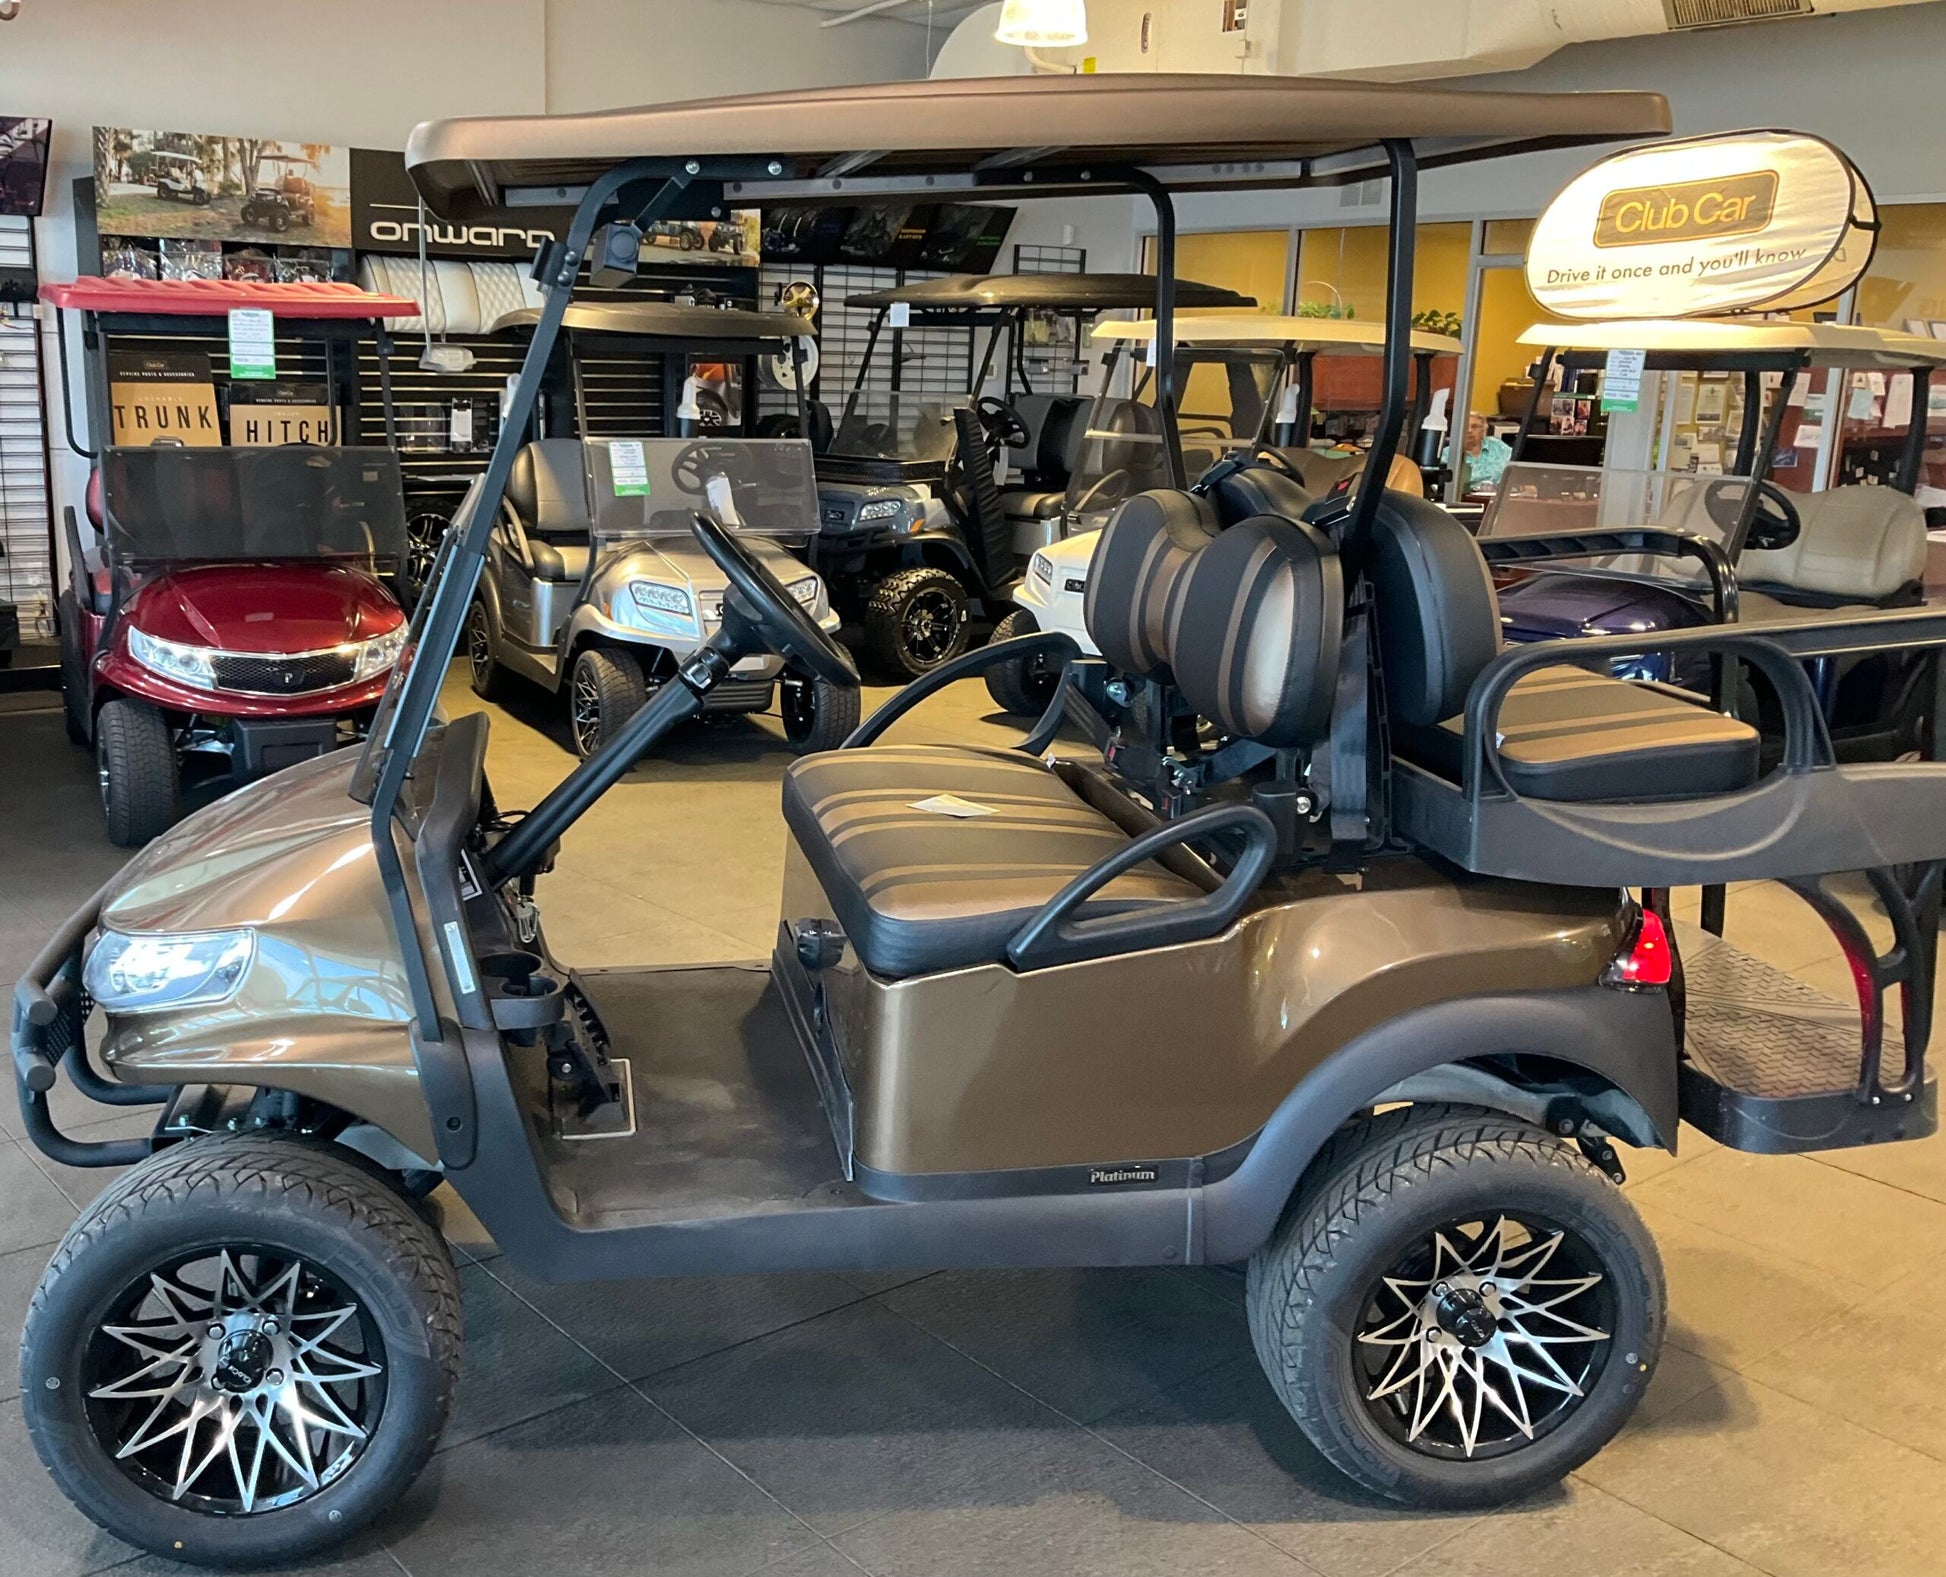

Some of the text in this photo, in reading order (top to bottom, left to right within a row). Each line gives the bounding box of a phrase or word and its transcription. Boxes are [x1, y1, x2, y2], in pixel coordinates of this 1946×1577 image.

[1614, 191, 1757, 233] Club Car
[1547, 269, 1590, 284] Drive
[1596, 265, 1607, 280] it
[1611, 266, 1652, 280] once
[1659, 256, 1693, 275] and
[1697, 249, 1749, 277] you'll
[1755, 247, 1807, 265] know
[114, 405, 212, 429] TRUNK
[246, 420, 329, 443] HITCH
[1090, 1170, 1155, 1183] Platinum
